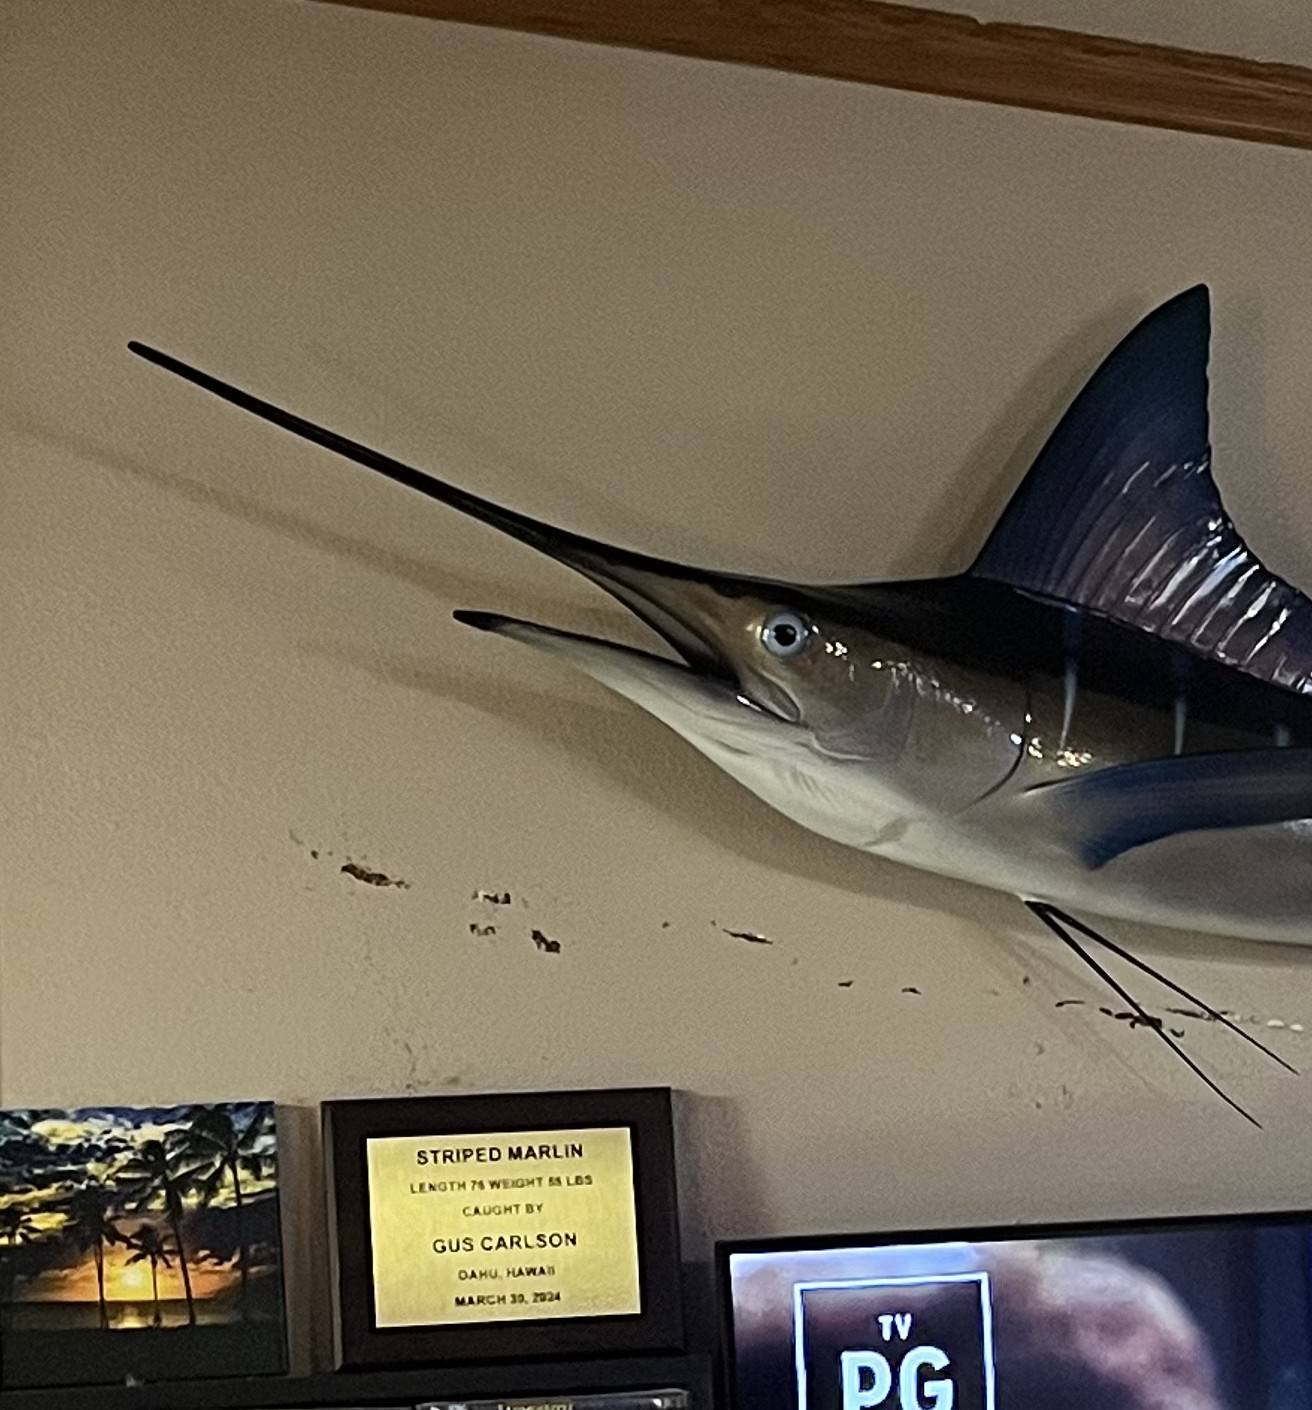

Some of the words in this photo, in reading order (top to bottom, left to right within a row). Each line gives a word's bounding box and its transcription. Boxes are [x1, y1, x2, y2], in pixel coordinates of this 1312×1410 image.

[416, 1147, 502, 1165] STRIPED
[508, 1144, 584, 1160] MARLIN
[410, 1180, 466, 1194] LENGTH
[488, 1176, 543, 1189] WEIGHT
[566, 1174, 593, 1186] LBS
[462, 1204, 521, 1217] CAUGHT
[525, 1203, 543, 1214] BY
[432, 1237, 474, 1253] GUS
[480, 1232, 578, 1250] CARLSON
[506, 1266, 556, 1278] HAWAII
[454, 1294, 506, 1307] MARCH
[532, 1291, 561, 1303] 2024
[877, 1312, 912, 1341] TV
[840, 1346, 954, 1410] PG
